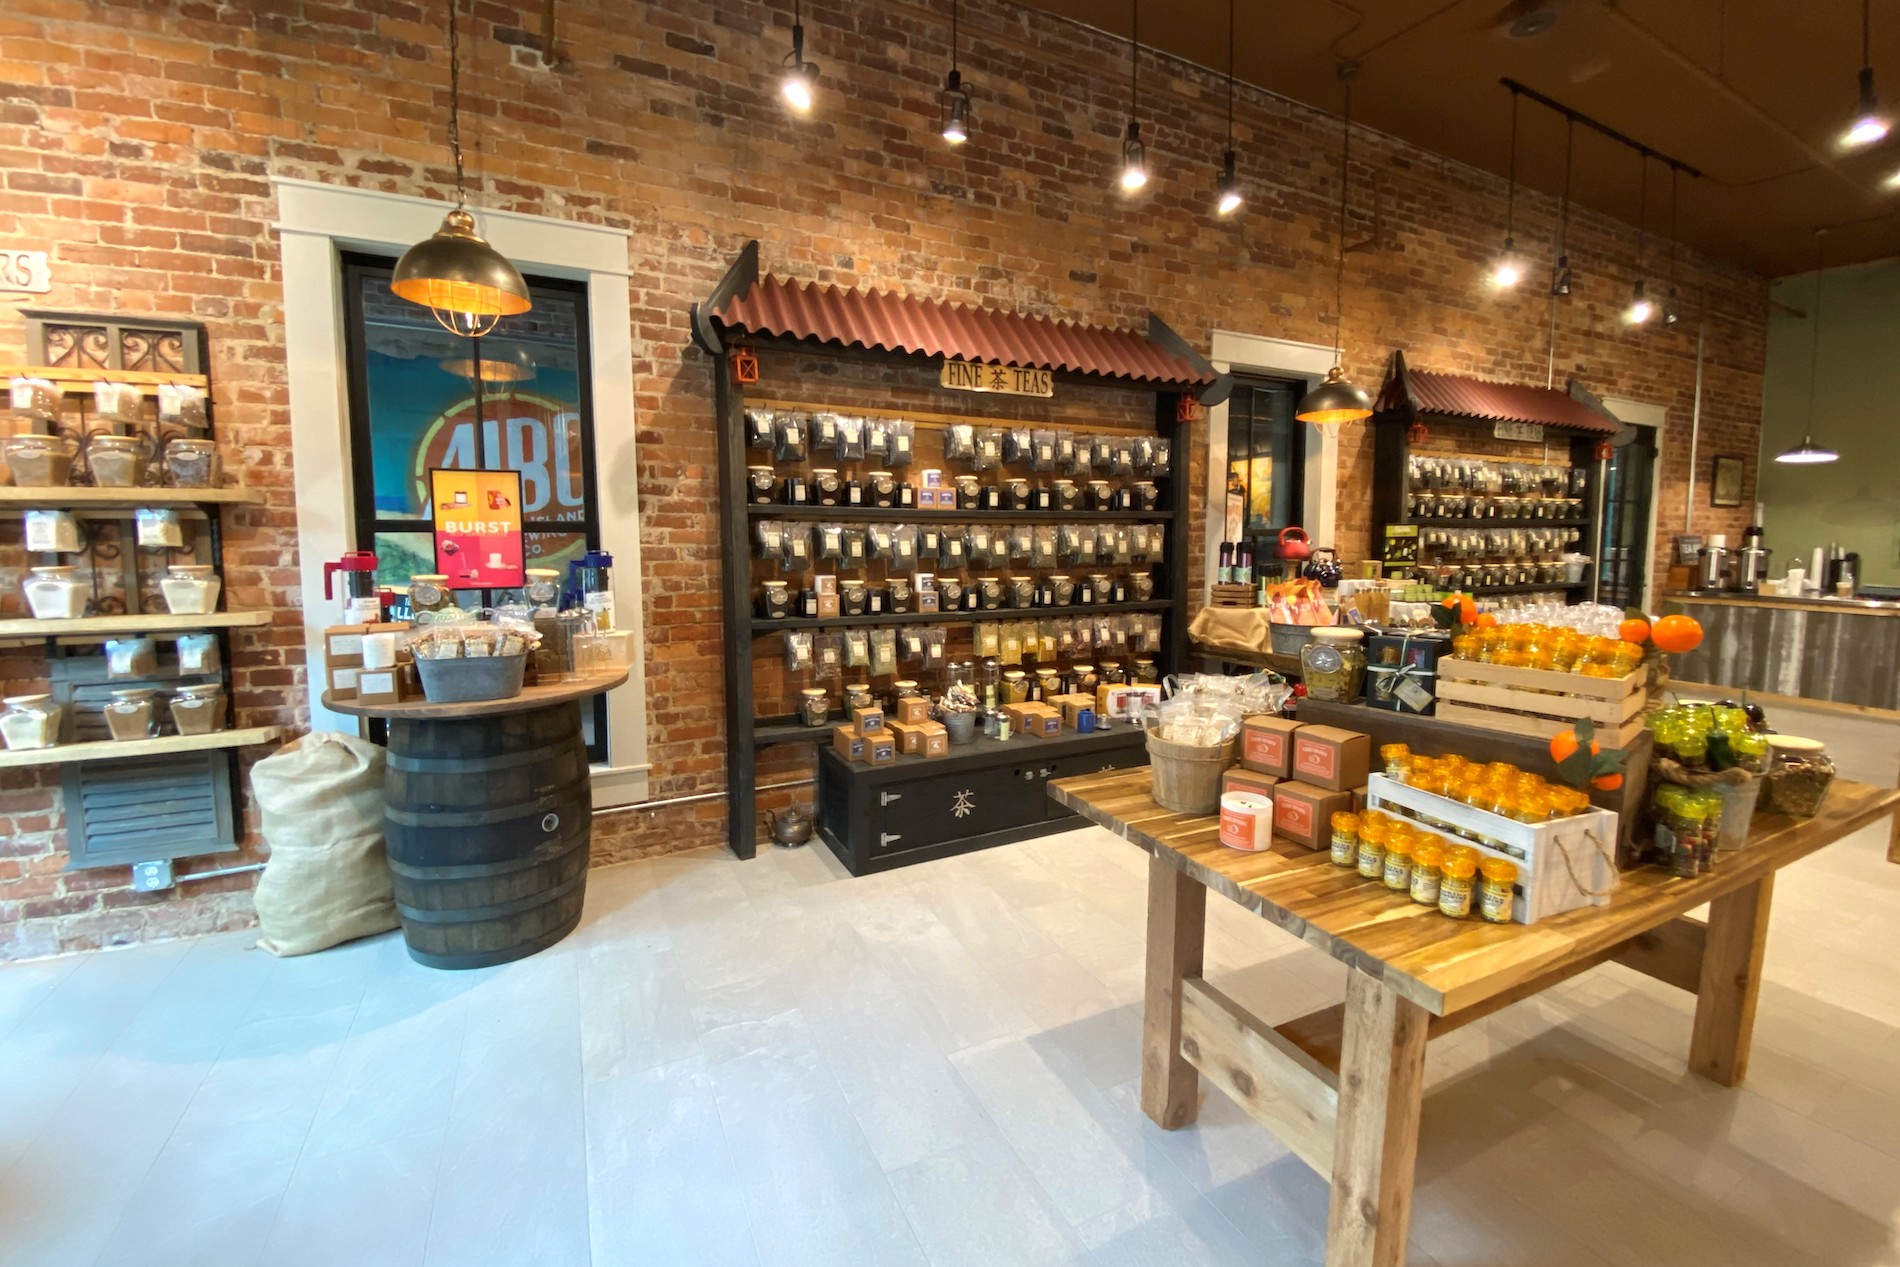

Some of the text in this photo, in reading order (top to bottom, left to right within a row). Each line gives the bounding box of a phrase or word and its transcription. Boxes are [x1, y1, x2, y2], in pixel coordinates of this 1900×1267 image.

[948, 362, 1049, 394] FINE 茶 TEAS
[444, 521, 512, 533] BURST
[949, 789, 976, 818] 茶
